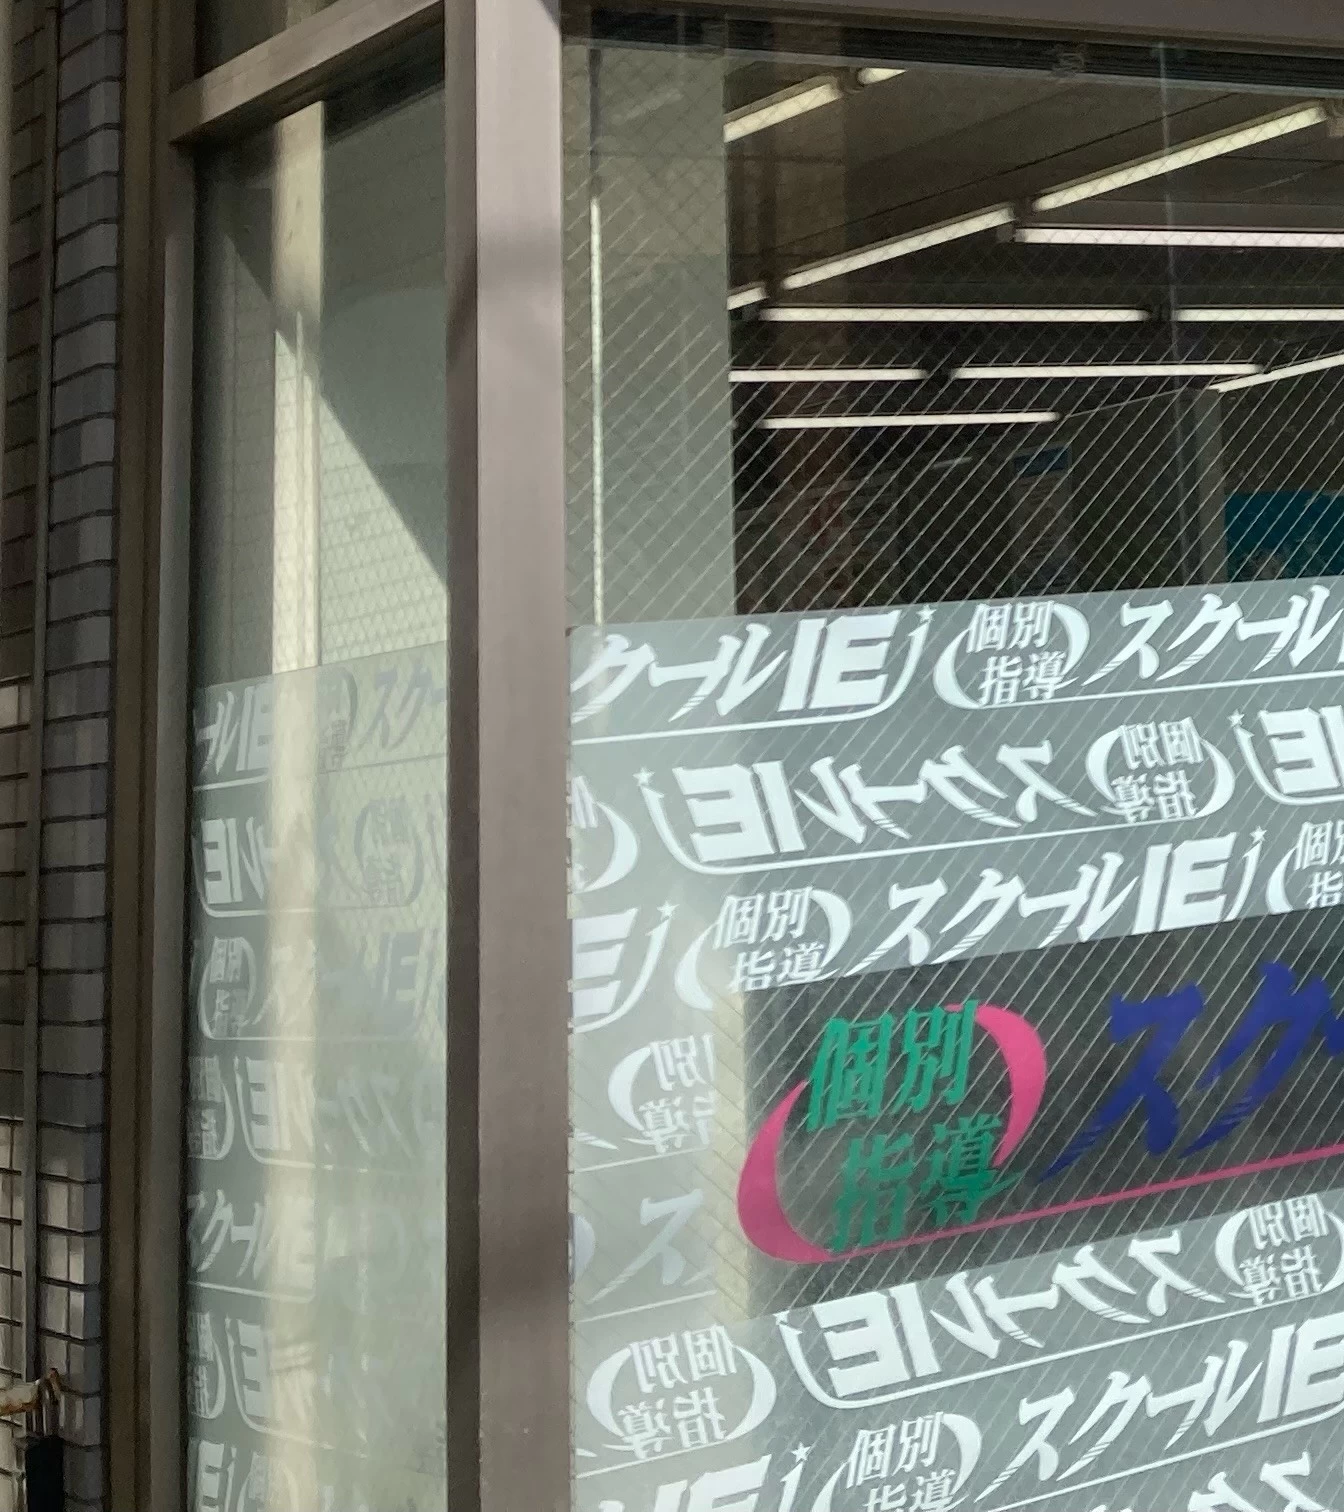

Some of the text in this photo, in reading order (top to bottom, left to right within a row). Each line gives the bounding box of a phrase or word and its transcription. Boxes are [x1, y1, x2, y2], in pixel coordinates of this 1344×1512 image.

[965, 599, 1057, 654] 個別
[976, 650, 1079, 706] 指導
[712, 887, 814, 950] 個別
[728, 943, 842, 992] 指導
[806, 999, 980, 1132] 個別
[830, 1114, 1022, 1253] 指導
[846, 1411, 943, 1488] 個別
